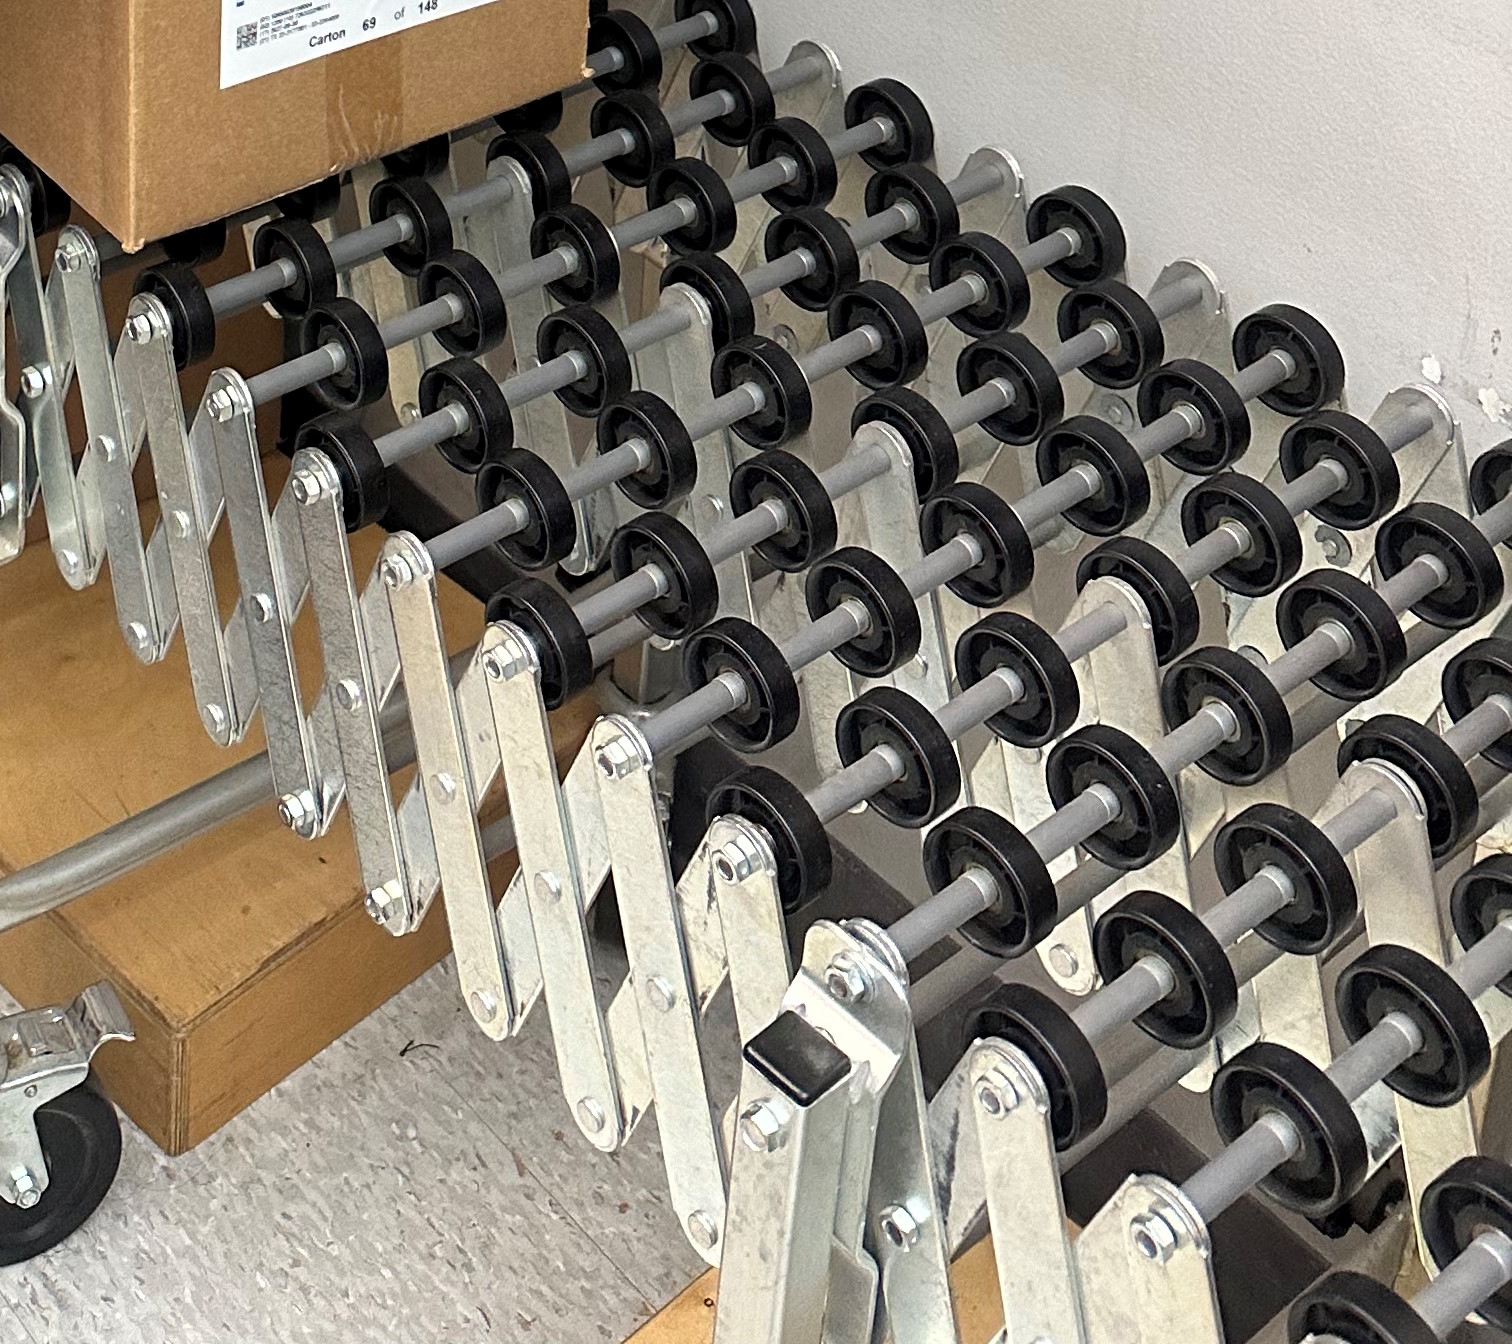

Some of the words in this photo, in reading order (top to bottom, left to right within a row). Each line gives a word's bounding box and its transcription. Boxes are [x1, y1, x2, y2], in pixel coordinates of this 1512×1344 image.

[309, 29, 346, 48] Carton
[362, 17, 377, 32] 69
[394, 6, 406, 20] of
